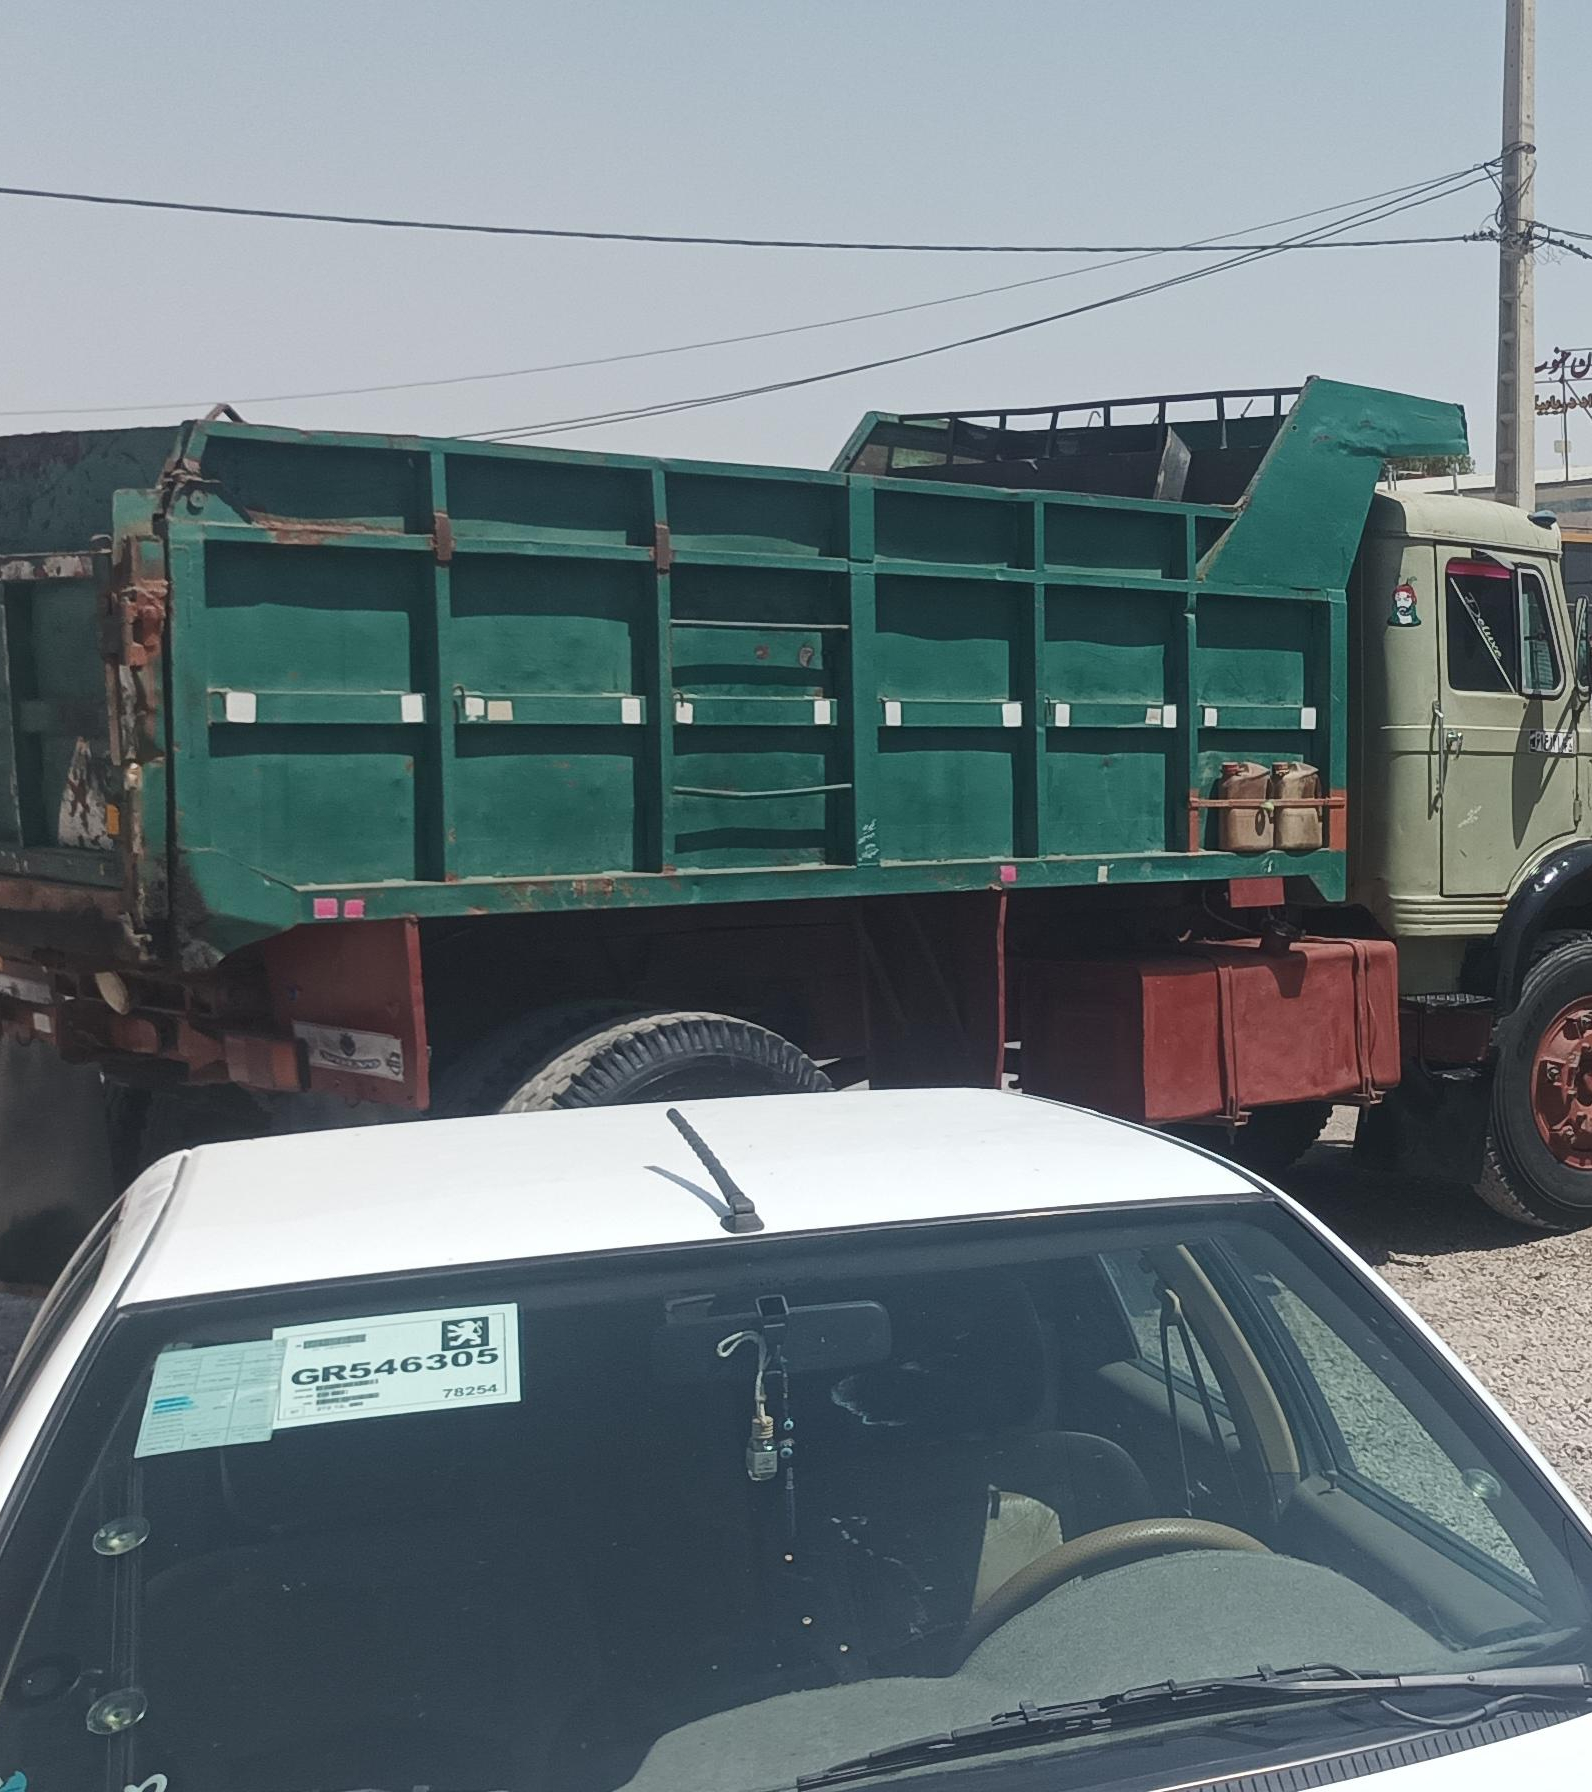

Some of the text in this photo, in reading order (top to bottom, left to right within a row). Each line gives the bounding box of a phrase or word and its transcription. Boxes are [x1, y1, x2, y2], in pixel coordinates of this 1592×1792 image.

[1465, 592, 1502, 660] Deluxe
[291, 1347, 499, 1386] GR546305
[442, 1384, 498, 1399] 78254
